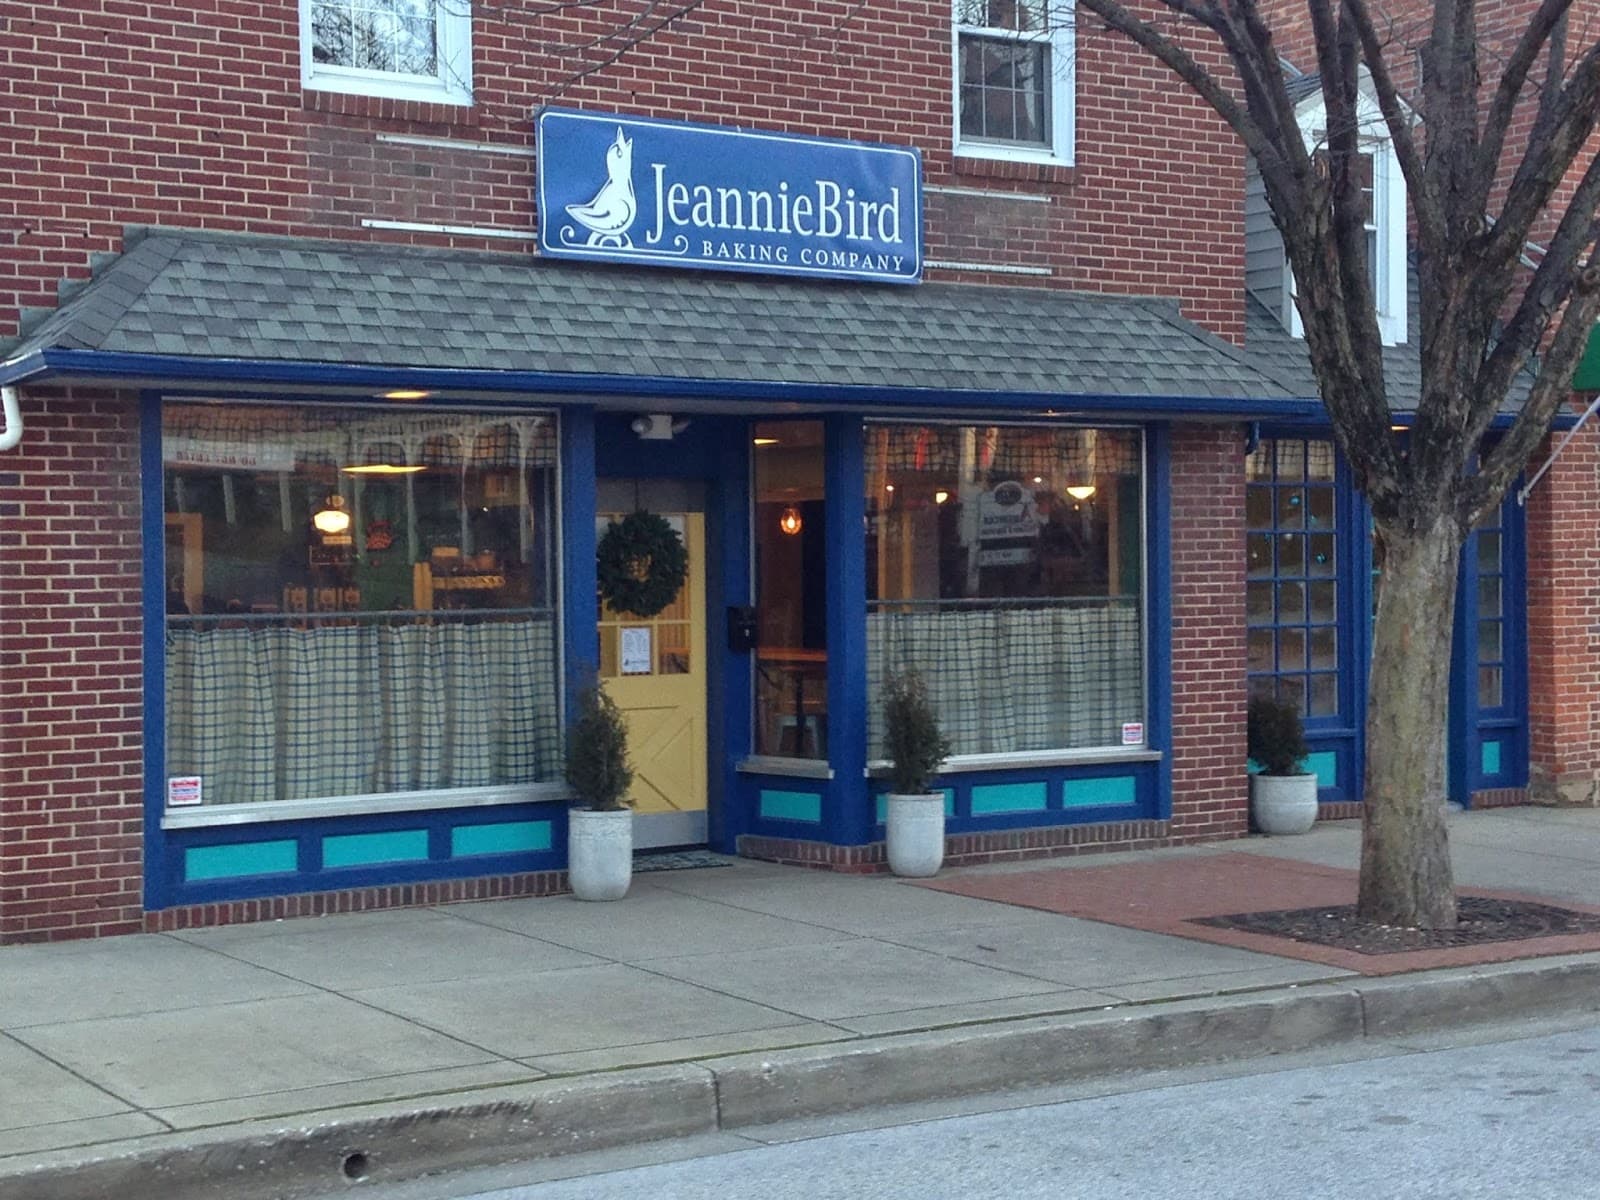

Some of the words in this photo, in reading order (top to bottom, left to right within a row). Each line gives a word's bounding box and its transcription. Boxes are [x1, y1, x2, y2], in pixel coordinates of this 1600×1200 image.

[646, 163, 904, 244] JeannieBird
[702, 240, 789, 263] BAKING
[801, 248, 904, 272] COMPANY
